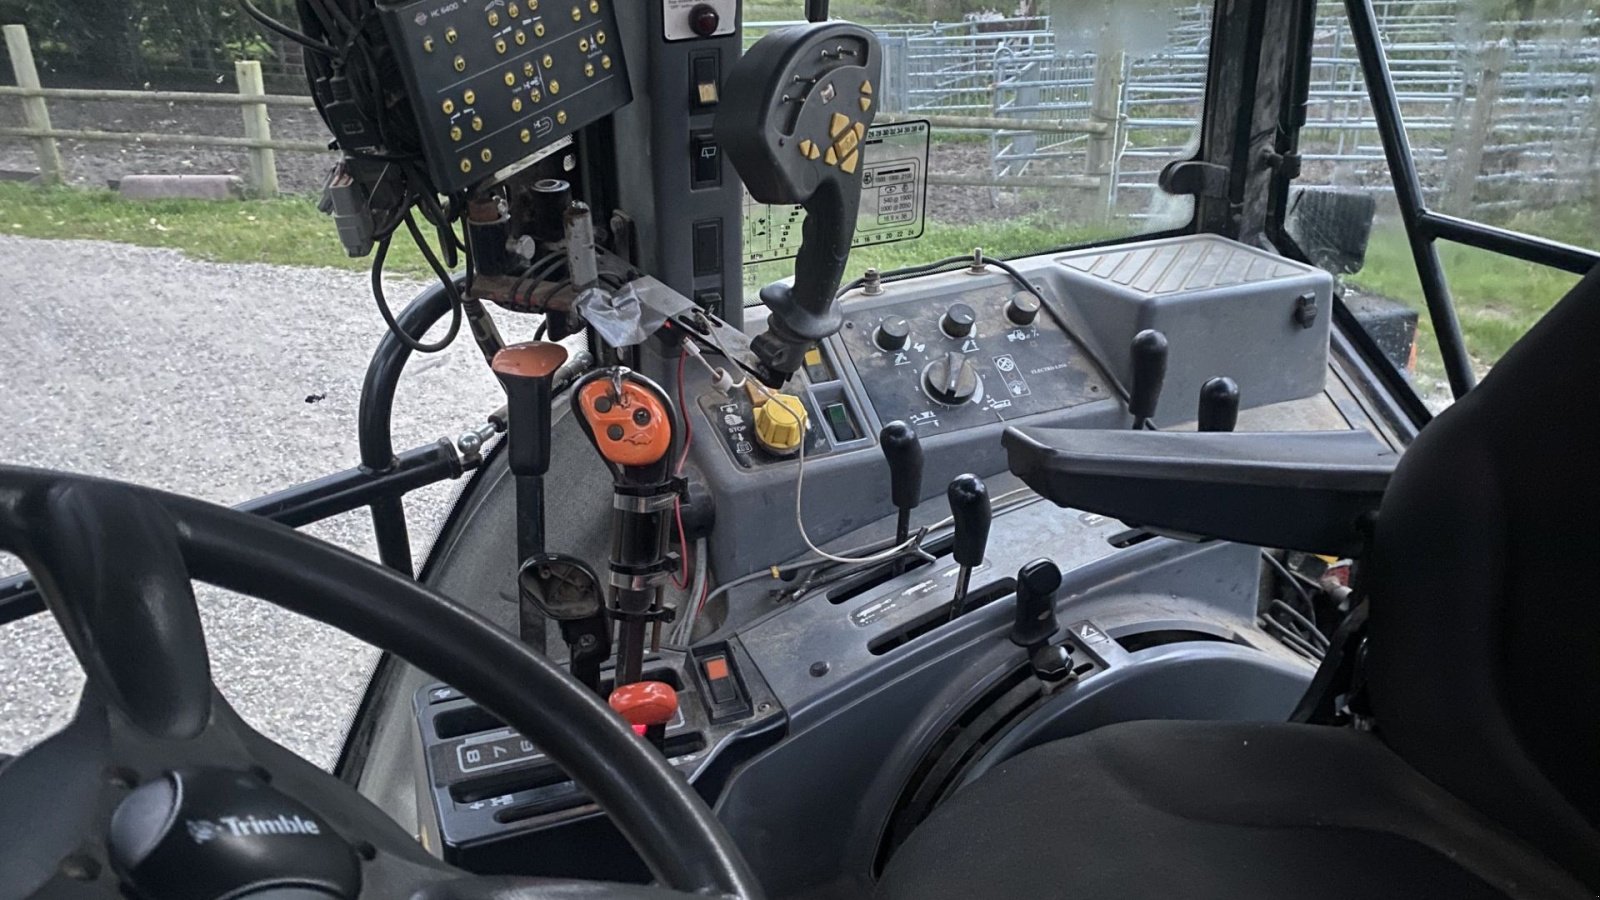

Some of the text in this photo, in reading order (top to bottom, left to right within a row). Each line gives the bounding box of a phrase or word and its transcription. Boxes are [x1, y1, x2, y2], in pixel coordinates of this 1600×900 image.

[440, 1, 459, 14] 6400
[728, 425, 747, 433] STOP
[466, 749, 480, 763] 8
[493, 746, 507, 758] 7
[220, 814, 320, 837] Trimble
